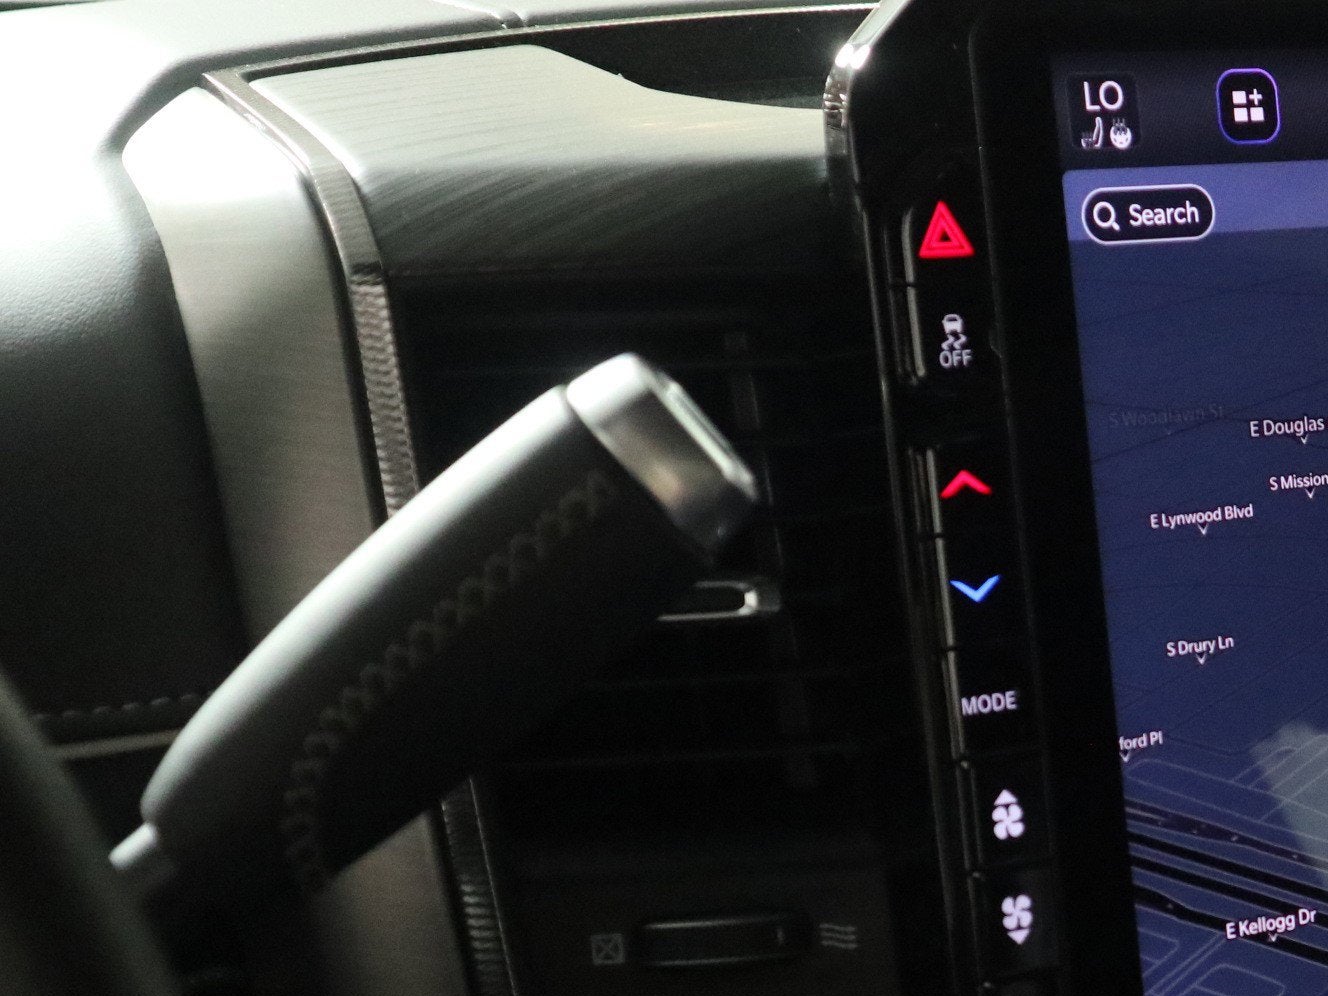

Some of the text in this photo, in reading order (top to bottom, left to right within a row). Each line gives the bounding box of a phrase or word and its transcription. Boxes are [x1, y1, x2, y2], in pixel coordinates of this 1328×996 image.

[1083, 80, 1124, 111] LO
[1129, 200, 1200, 228] Search
[939, 349, 972, 369] OFF
[1250, 421, 1260, 437] E
[1263, 415, 1325, 437] Douglas
[1269, 476, 1278, 491] S
[1281, 472, 1328, 490] Mission
[1150, 503, 1254, 529] E Lynwood Blvd
[1166, 635, 1234, 657] S Drury Ln
[961, 690, 1018, 716] MODE
[1226, 908, 1316, 940] E Kellogg Dr
